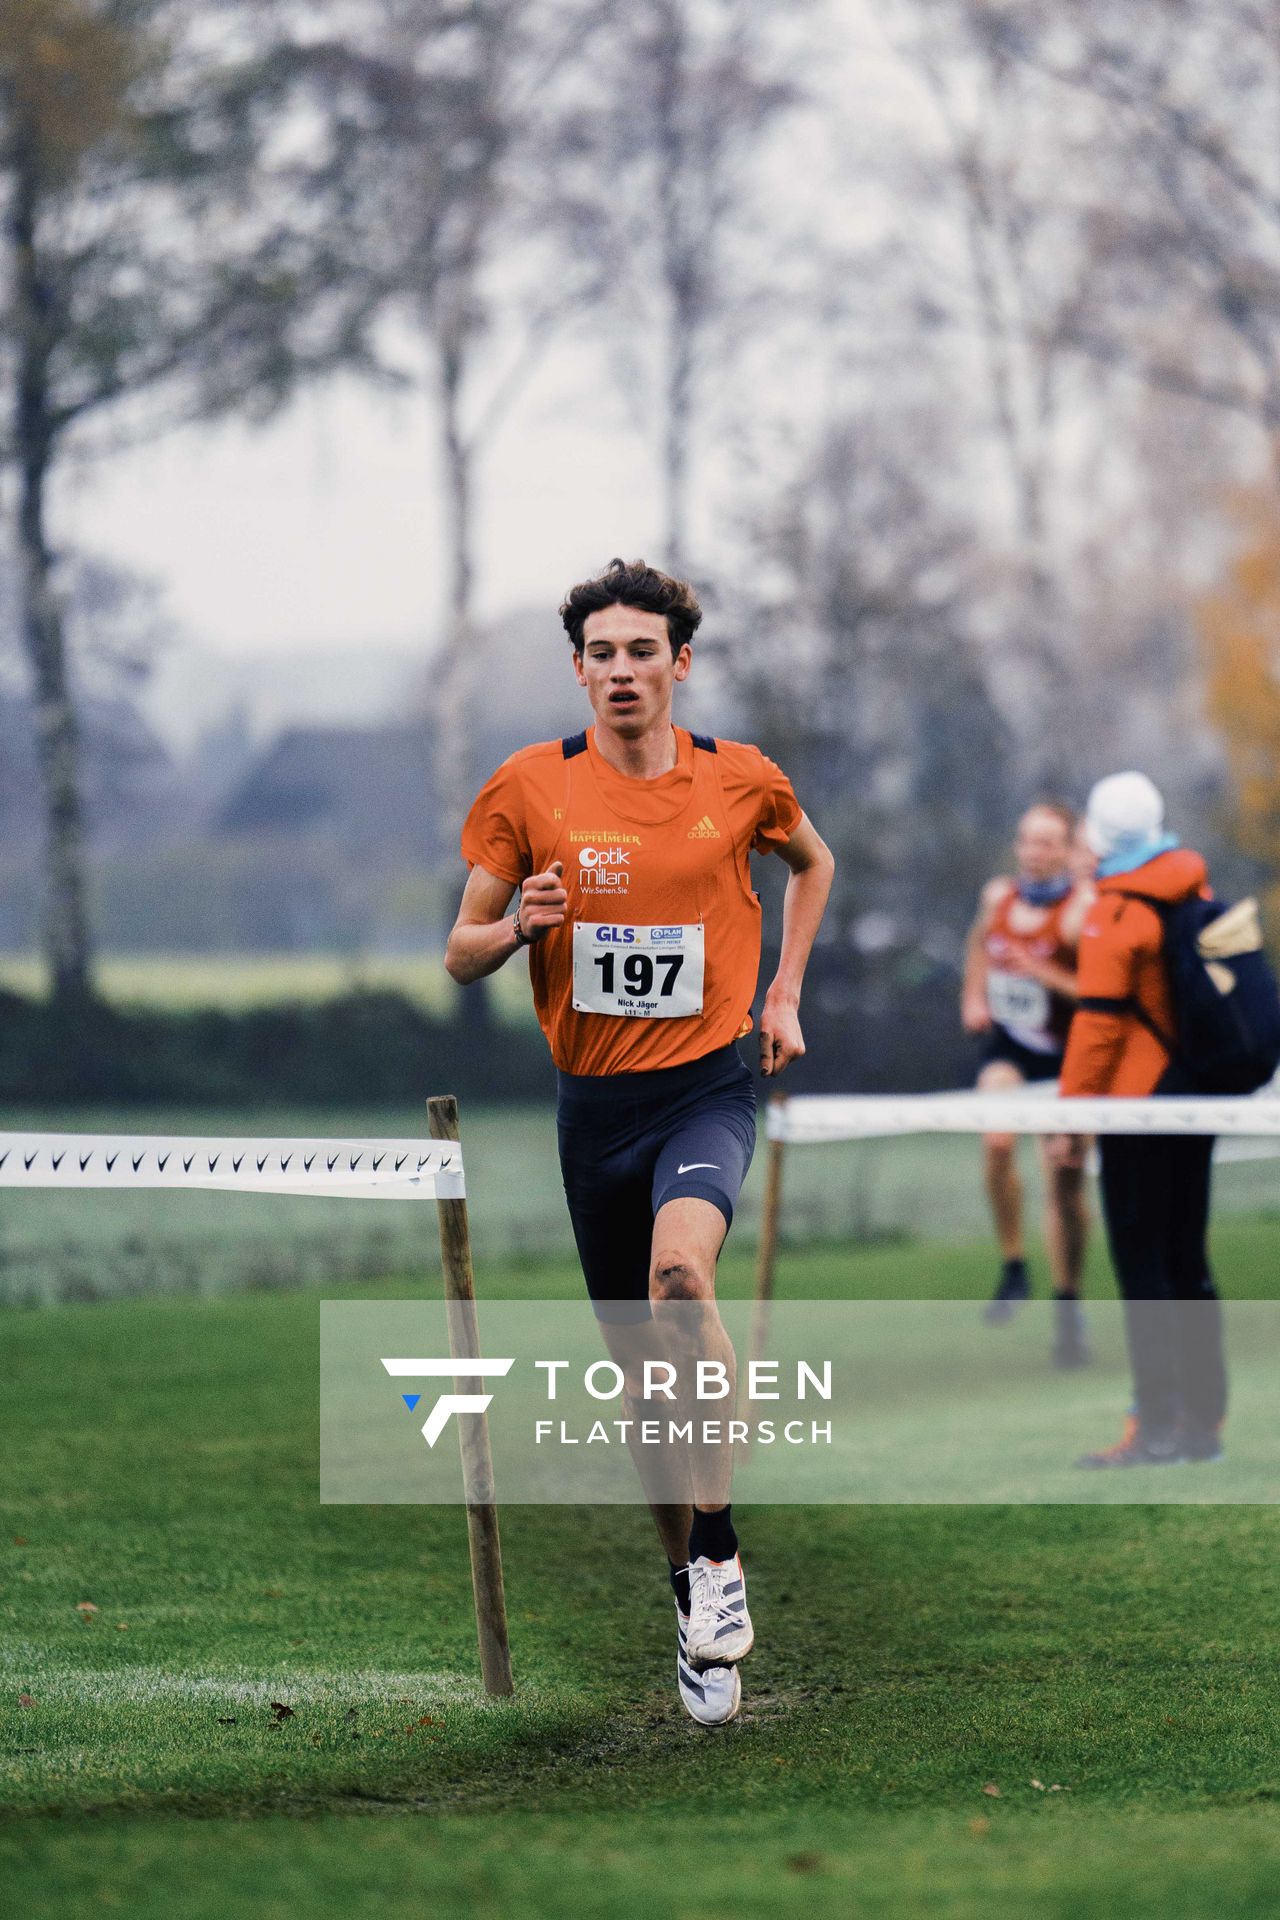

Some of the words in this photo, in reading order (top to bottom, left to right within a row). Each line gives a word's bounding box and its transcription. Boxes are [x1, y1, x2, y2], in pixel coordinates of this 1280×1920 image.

[687, 830, 721, 839] adidas
[578, 847, 631, 868] Optik
[594, 952, 684, 997] 197
[617, 998, 634, 1008] Nick
[636, 1000, 658, 1010] Jäger
